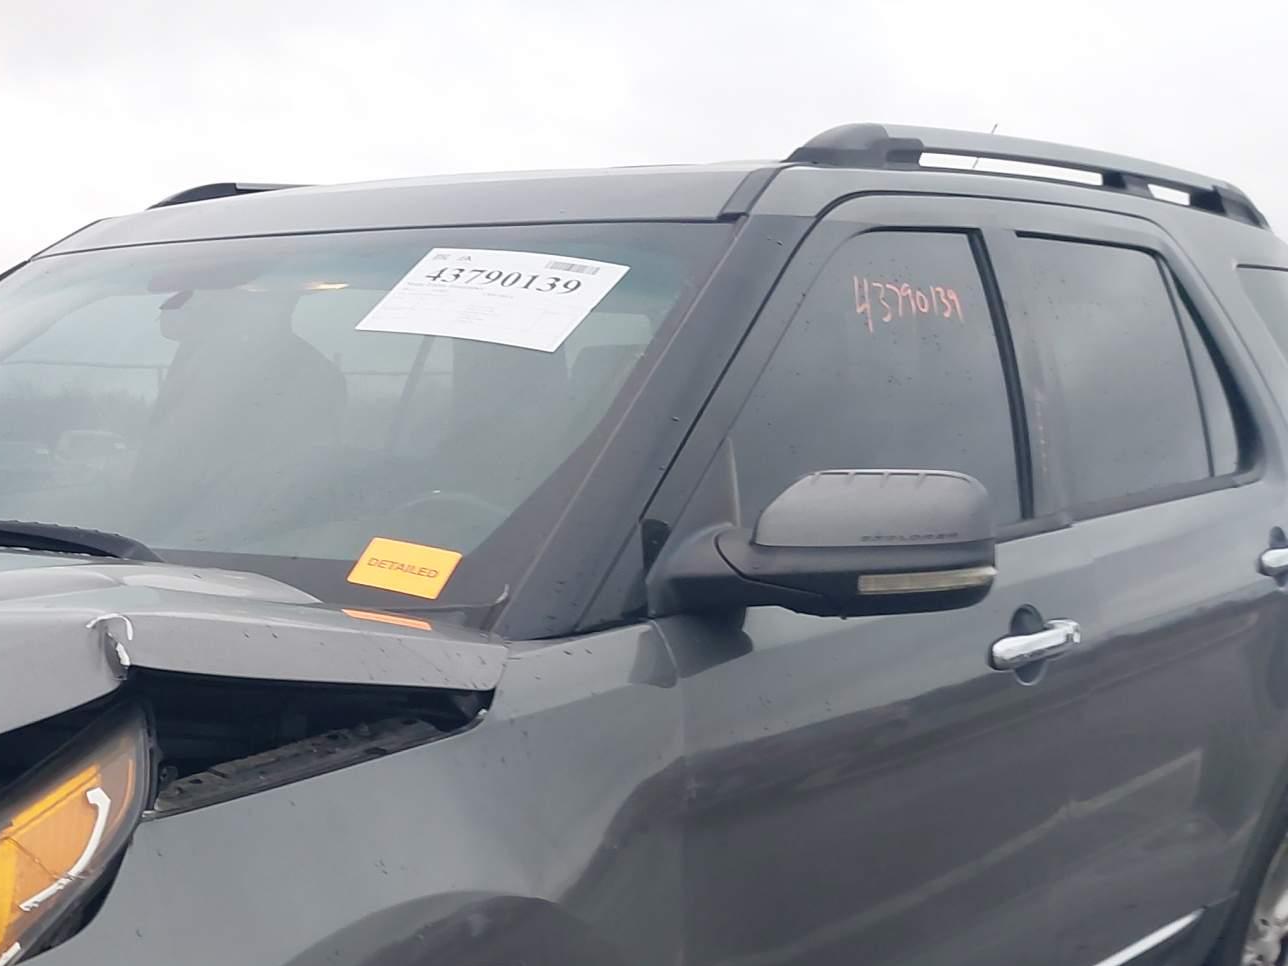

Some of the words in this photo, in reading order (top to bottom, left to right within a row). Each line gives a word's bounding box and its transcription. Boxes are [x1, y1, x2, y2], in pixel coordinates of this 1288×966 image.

[425, 266, 583, 295] 43790139
[853, 275, 964, 333] 43790139
[367, 557, 439, 578] DETAILED
